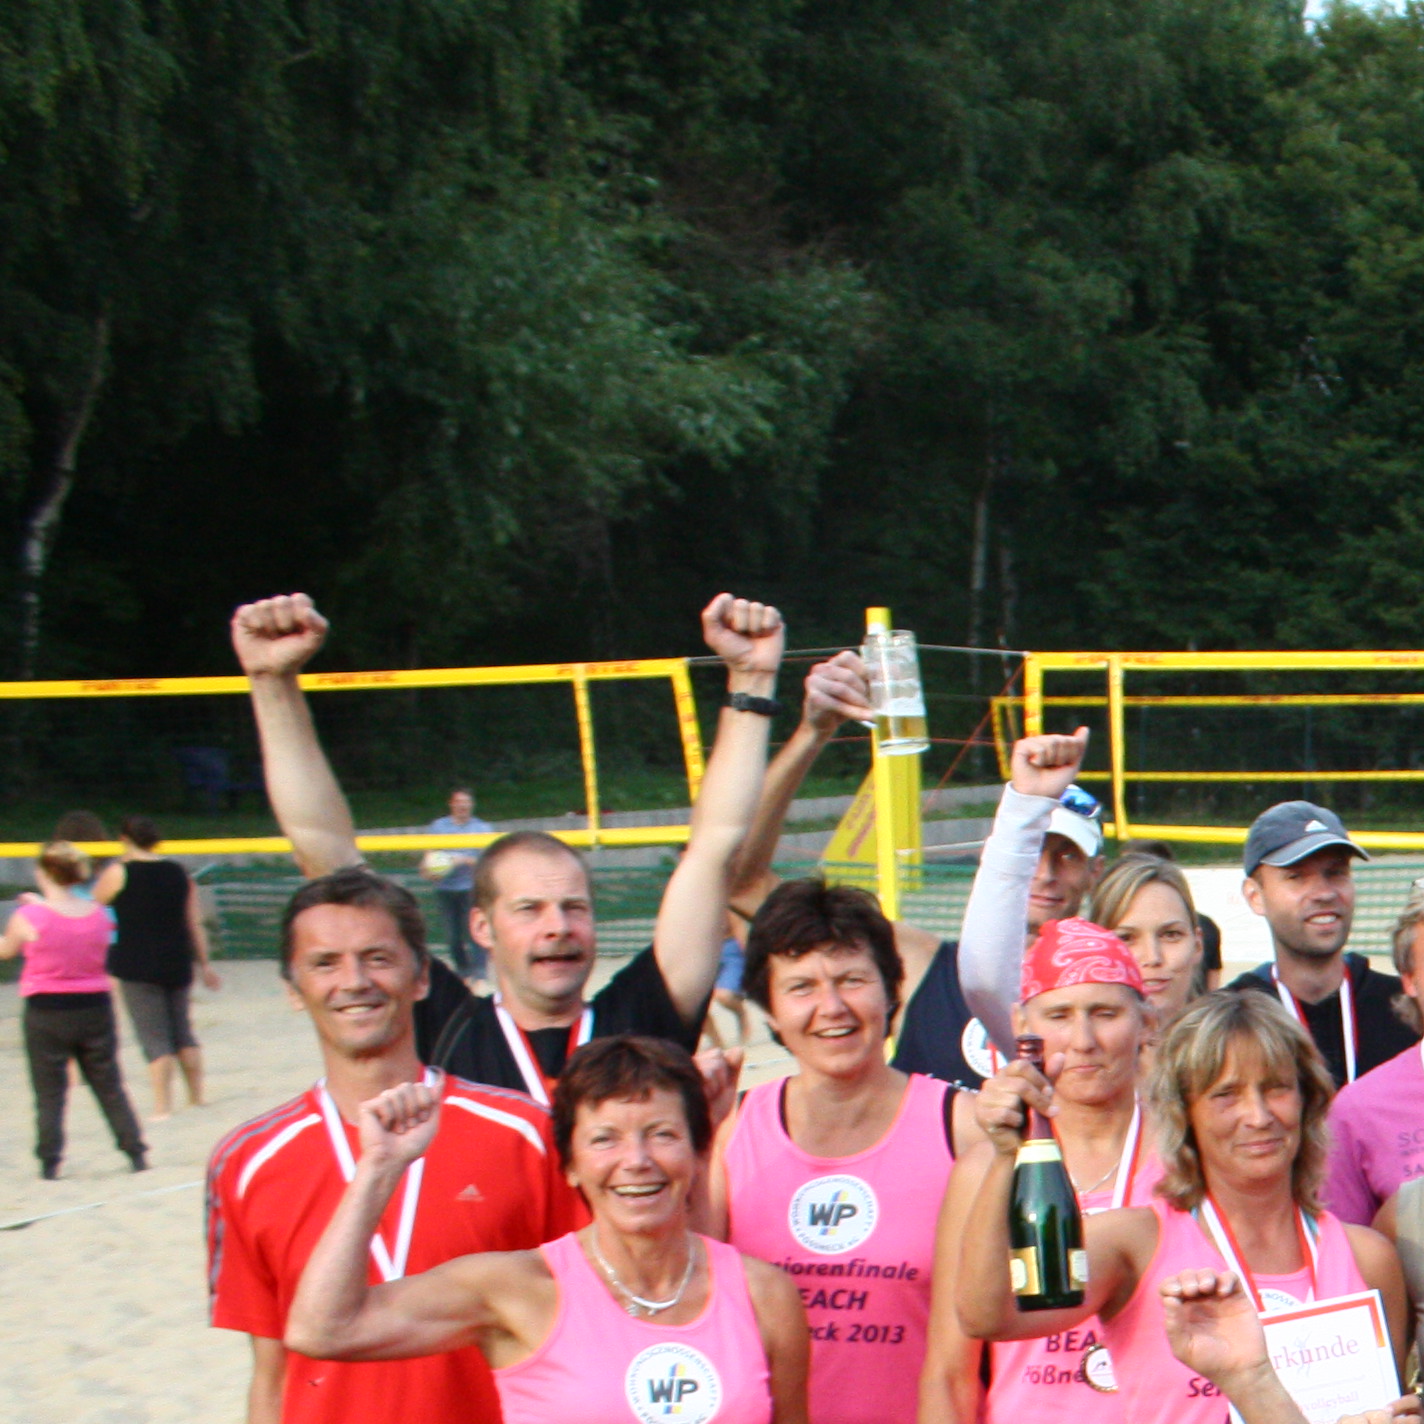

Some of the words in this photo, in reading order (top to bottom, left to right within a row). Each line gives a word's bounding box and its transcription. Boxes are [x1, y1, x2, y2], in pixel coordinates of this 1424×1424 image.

[808, 1202, 859, 1227] WP
[798, 1288, 869, 1310] EACH
[845, 1323, 906, 1344] 2013
[1046, 1331, 1097, 1352] BEA
[1273, 1335, 1360, 1370] rkunde
[647, 1378, 699, 1403] WP
[1304, 1390, 1360, 1411] volleyball
